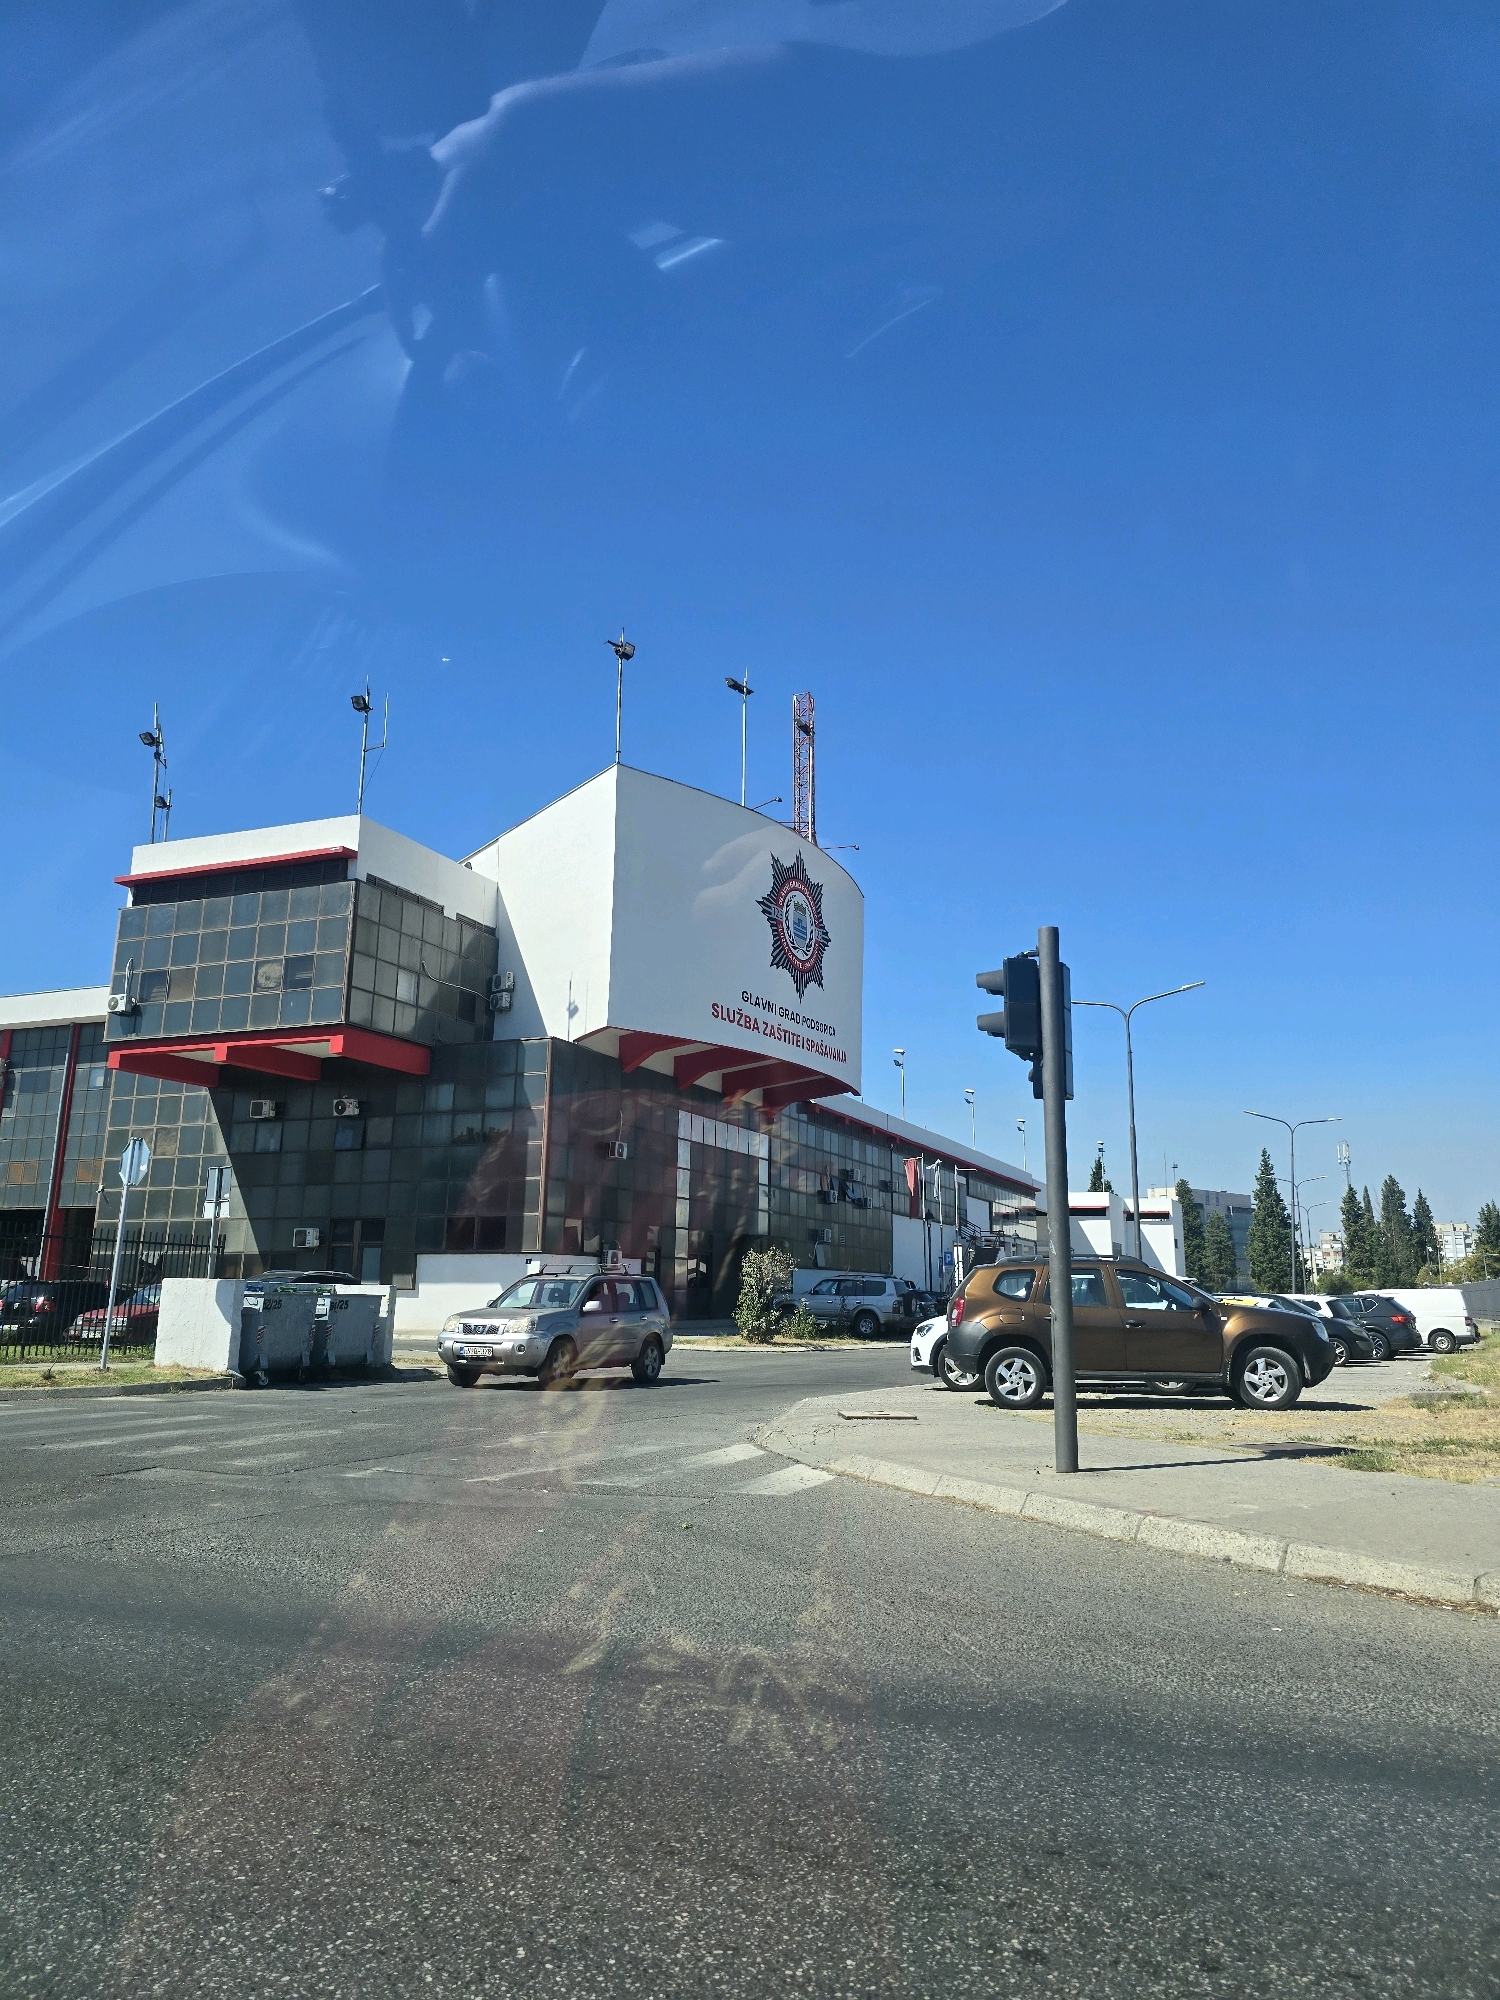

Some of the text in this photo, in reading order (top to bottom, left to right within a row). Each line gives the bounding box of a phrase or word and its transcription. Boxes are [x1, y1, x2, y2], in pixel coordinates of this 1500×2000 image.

[711, 1002, 847, 1064] SLUŽBA ZAŠTITE I SPAŠAVANJA
[742, 991, 836, 1038] GLAVNI GRAD PODGORICA
